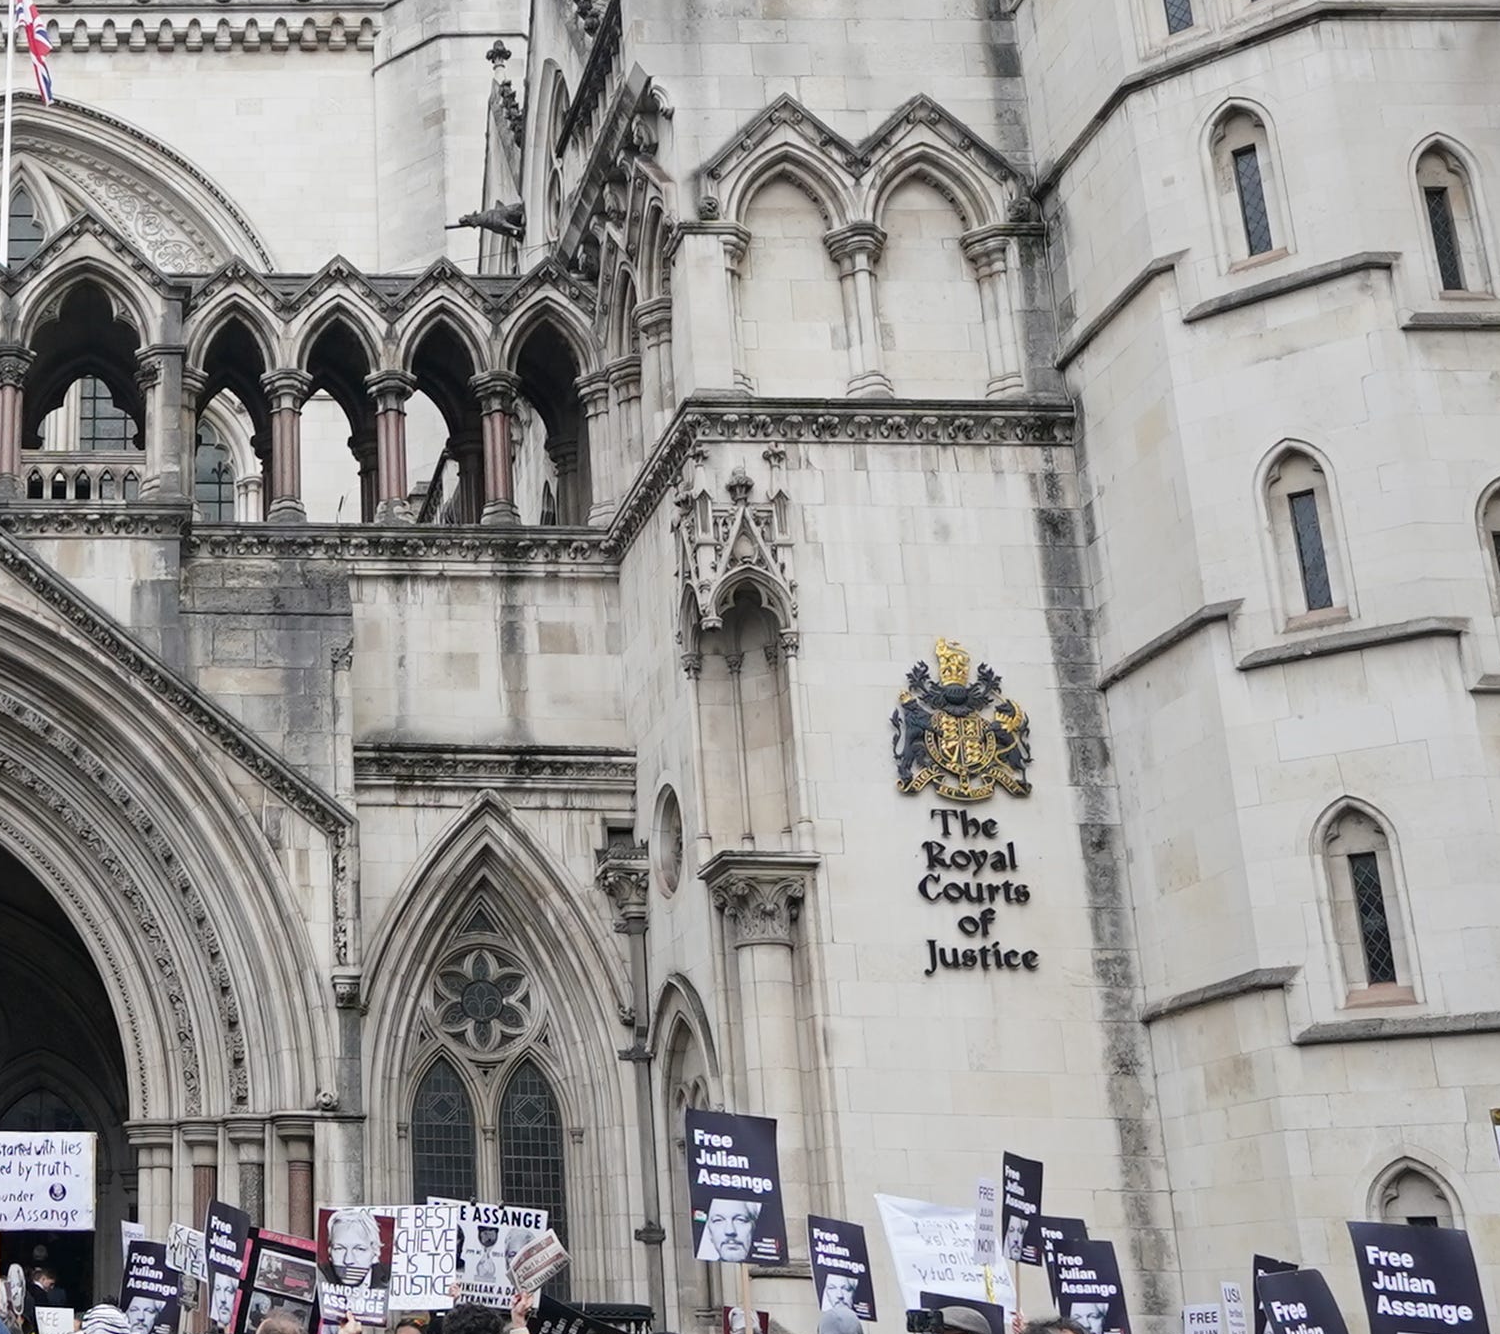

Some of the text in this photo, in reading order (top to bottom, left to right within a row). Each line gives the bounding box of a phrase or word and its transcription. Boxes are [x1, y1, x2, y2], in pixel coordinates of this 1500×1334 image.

[931, 809, 1000, 839] The
[921, 841, 1019, 876] Royal
[918, 874, 1031, 906] Courts
[957, 907, 997, 938] of
[924, 940, 1040, 977] Justice
[61, 1138, 82, 1156] lies
[694, 1129, 733, 1148] Free
[696, 1149, 749, 1169] Julian
[18, 1162, 32, 1182] by
[697, 1169, 773, 1194] Assange
[13, 1206, 79, 1228] Assange
[211, 1216, 232, 1234] Free
[414, 1207, 456, 1230] BEST
[472, 1207, 542, 1230] ASSANGE
[813, 1228, 839, 1243] Free
[1041, 1227, 1064, 1241] Free
[131, 1252, 155, 1266] Free
[815, 1241, 850, 1257] Julian
[1365, 1245, 1415, 1268] Free
[406, 1253, 418, 1274] IS
[427, 1252, 454, 1274] TO
[817, 1255, 865, 1273] Assange
[1057, 1253, 1083, 1266] Free
[129, 1265, 163, 1280] Julian
[1059, 1267, 1097, 1280] Julian
[127, 1277, 178, 1296] Assange
[322, 1282, 386, 1302] HANDS OFF
[1061, 1281, 1117, 1297] Assange
[1372, 1271, 1437, 1295] Julian
[322, 1294, 384, 1315] ASSANGE
[461, 1294, 499, 1306] TYRANNY
[1377, 1295, 1473, 1325] Assange
[1189, 1310, 1218, 1324] FREE
[1270, 1301, 1307, 1323] Free
